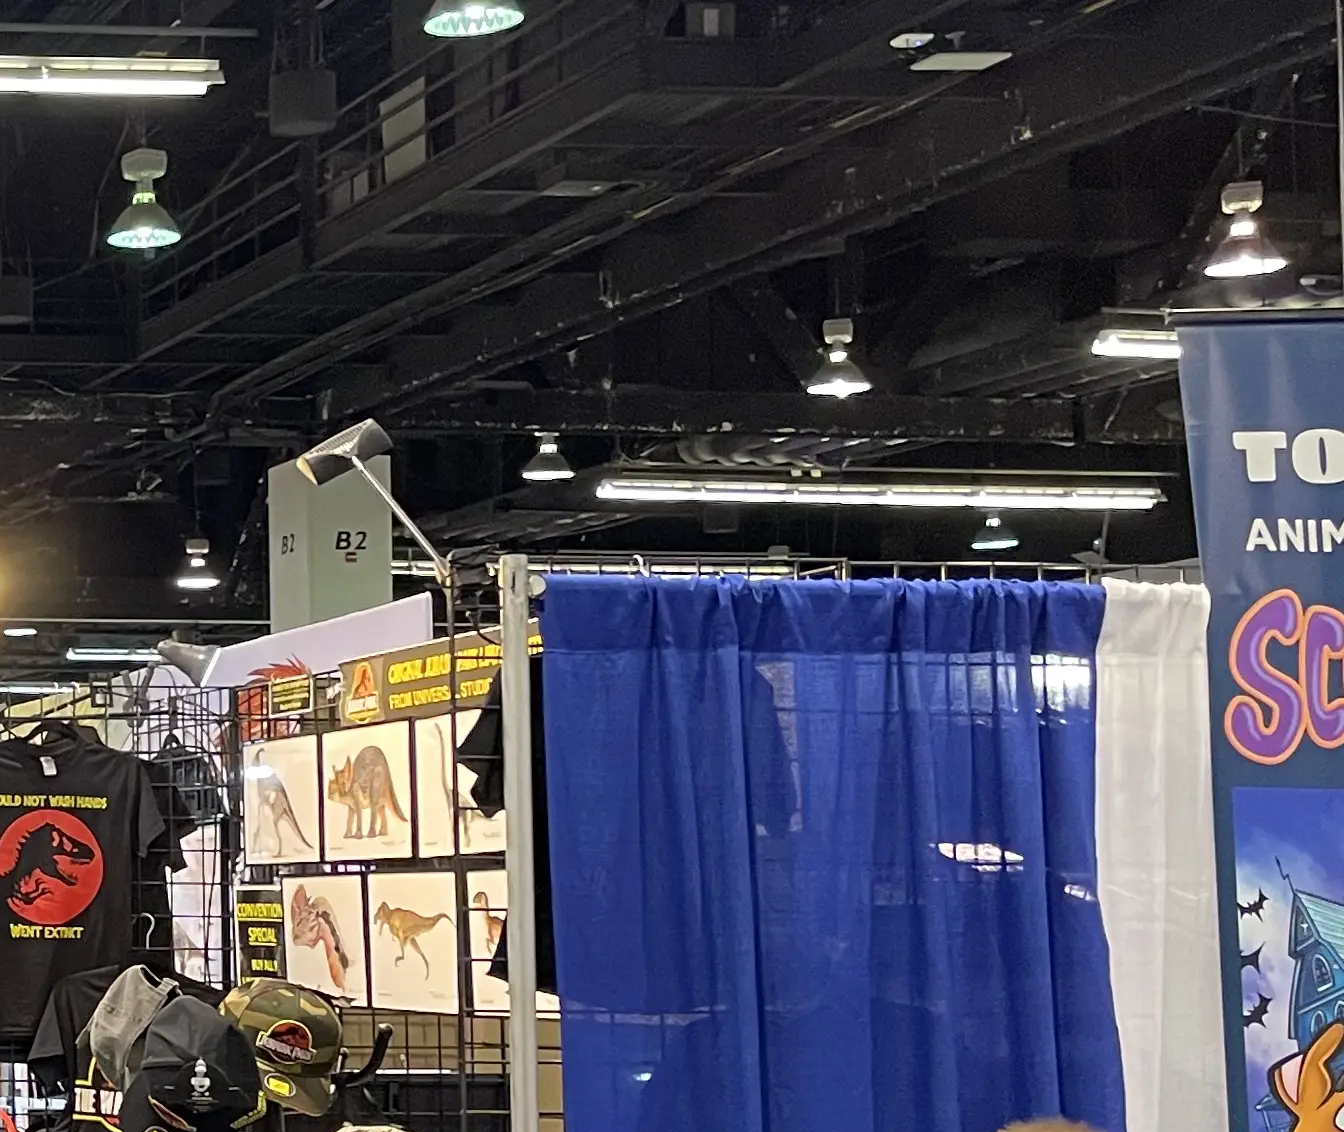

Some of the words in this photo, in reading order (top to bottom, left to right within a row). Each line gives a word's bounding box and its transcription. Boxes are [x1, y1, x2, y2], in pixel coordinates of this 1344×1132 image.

[281, 533, 295, 556] B2
[335, 530, 367, 550] B2
[389, 692, 412, 710] FROM
[23, 794, 47, 807] NOT
[48, 795, 75, 808] WASH
[76, 795, 108, 809] HANDS
[237, 902, 283, 918] CONVENTION
[9, 923, 43, 938] WENT
